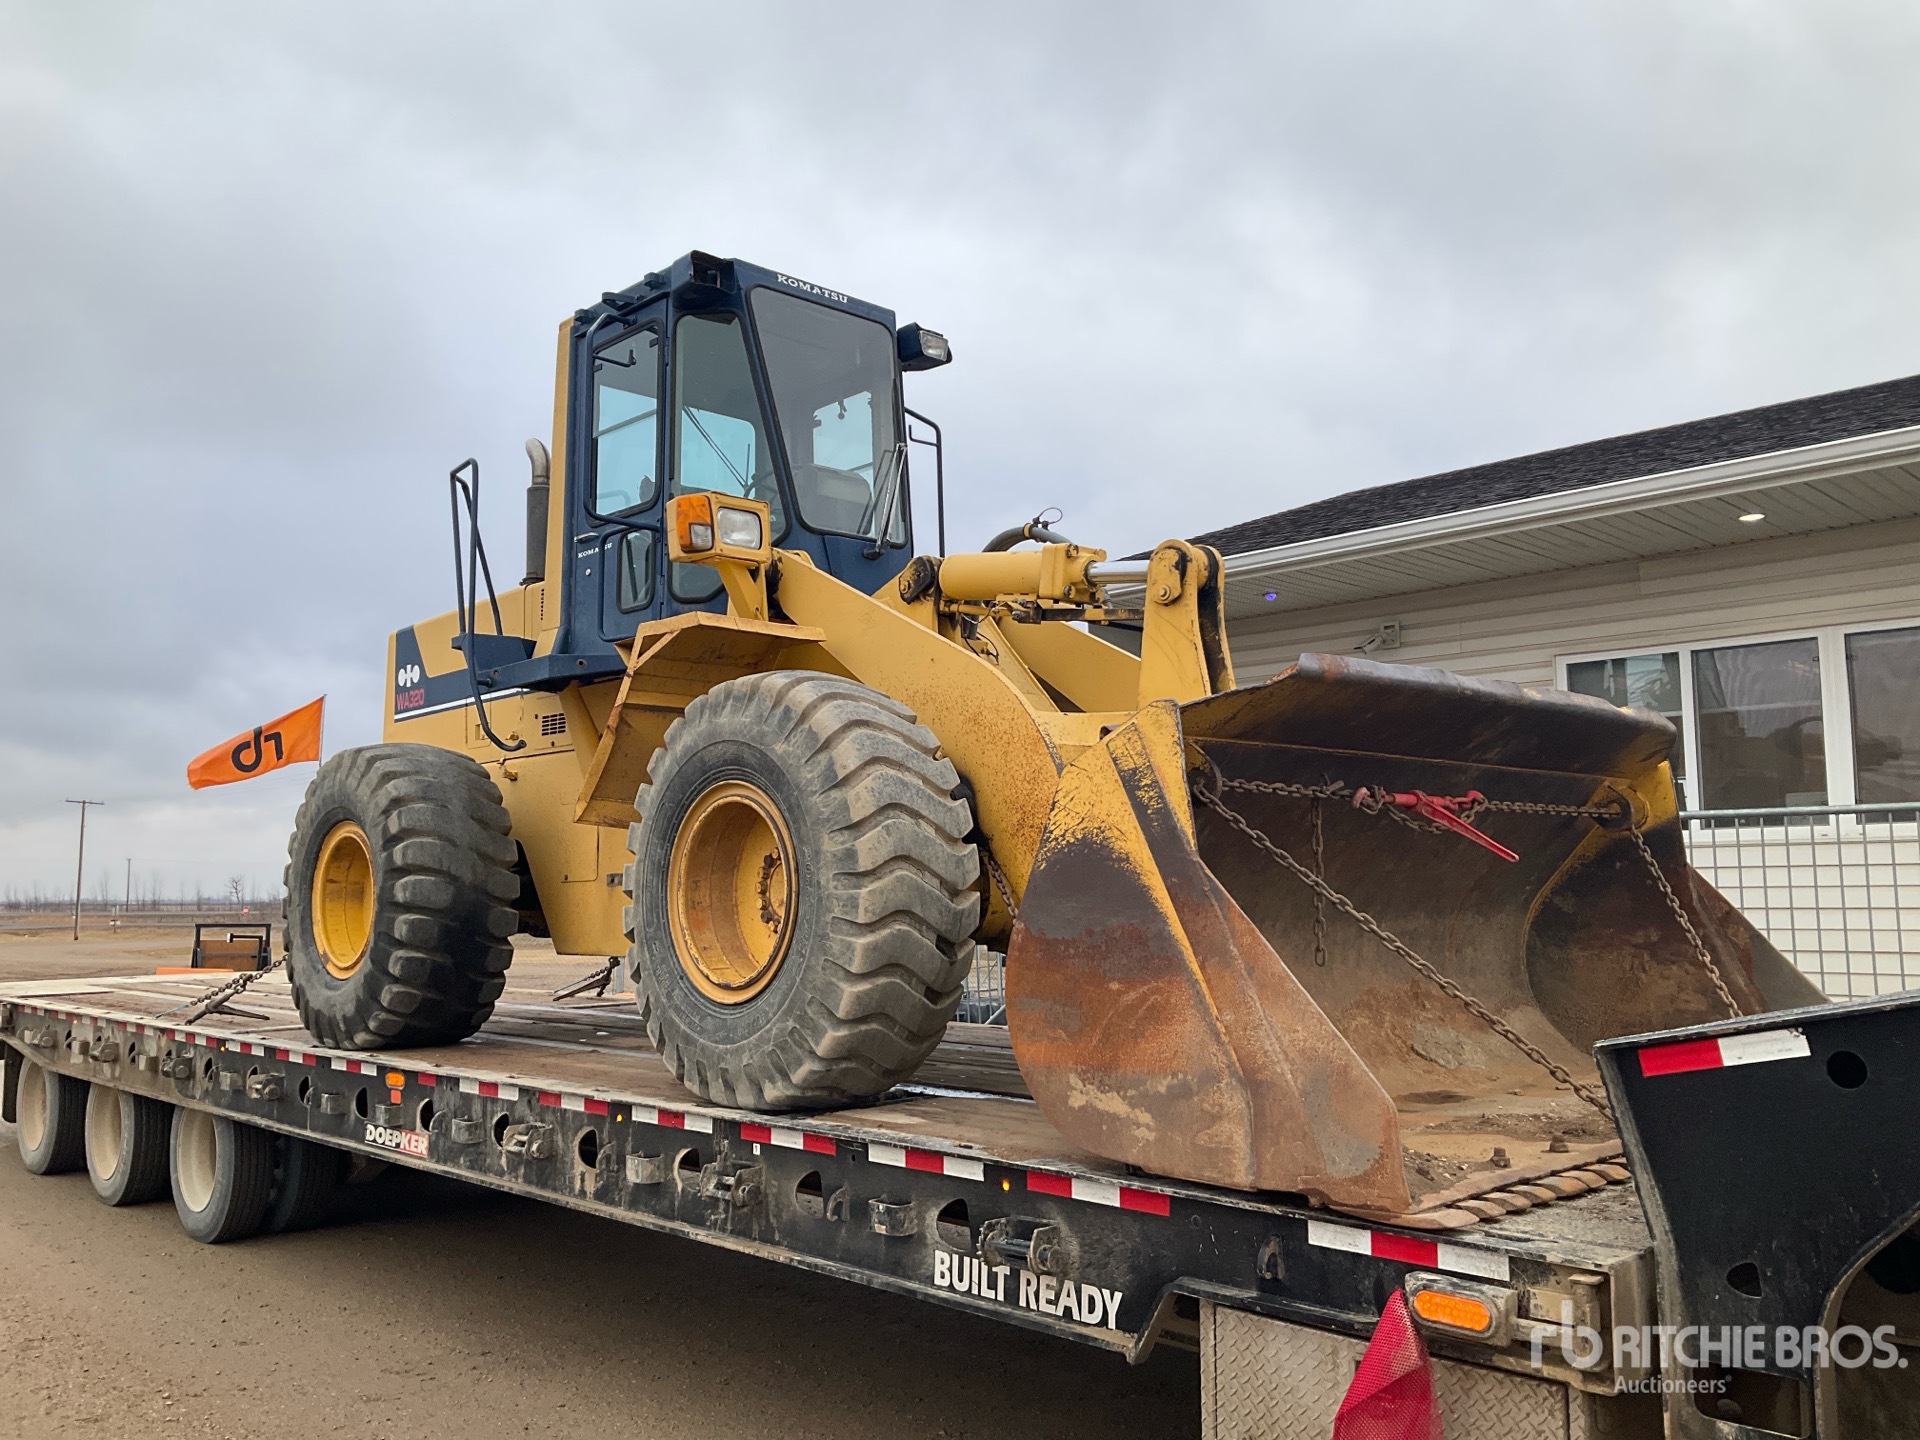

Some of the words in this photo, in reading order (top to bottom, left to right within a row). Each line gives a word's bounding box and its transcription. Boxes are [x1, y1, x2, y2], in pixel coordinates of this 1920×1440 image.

[777, 274, 848, 303] KOMATSU
[396, 688, 424, 711] WA320
[365, 1124, 428, 1156] DOEPKER
[934, 1249, 1011, 1302] BUILT
[1018, 1268, 1123, 1330] READY
